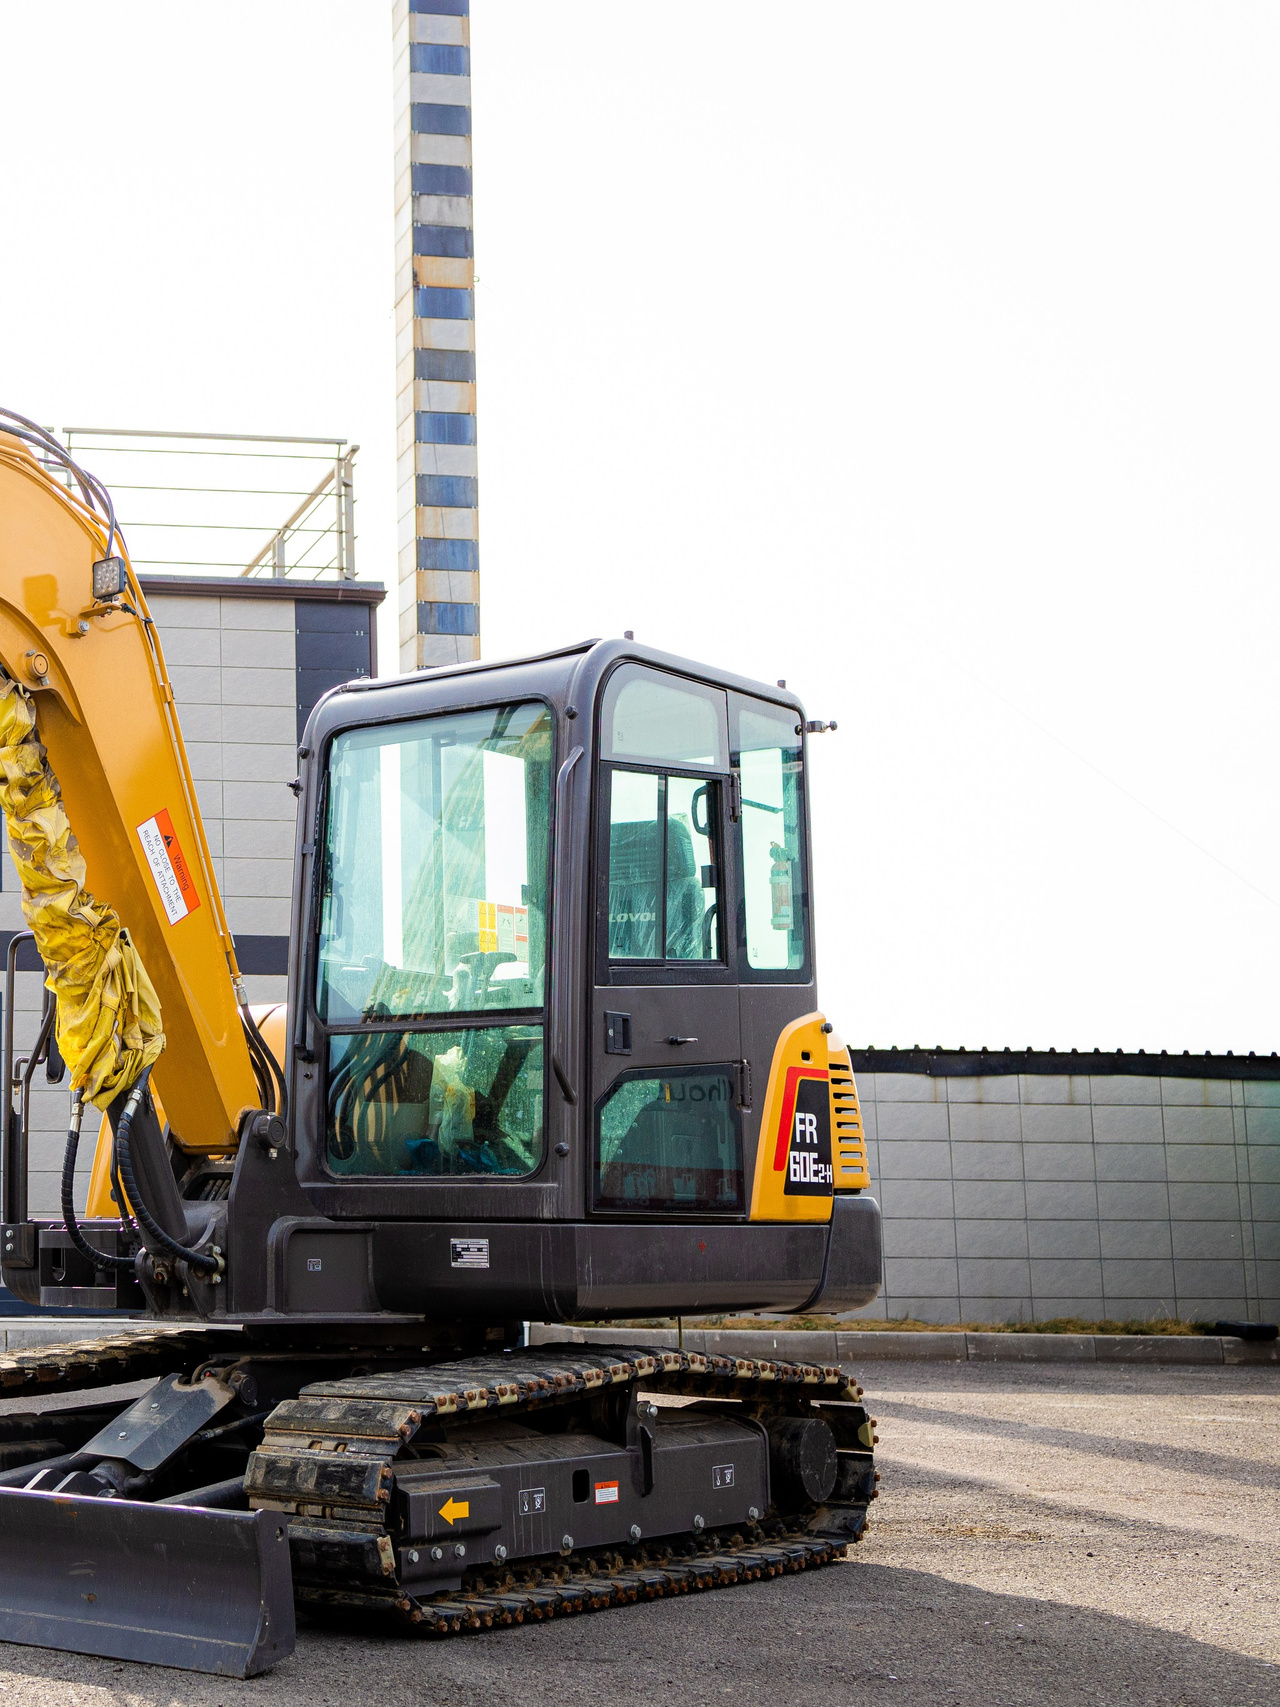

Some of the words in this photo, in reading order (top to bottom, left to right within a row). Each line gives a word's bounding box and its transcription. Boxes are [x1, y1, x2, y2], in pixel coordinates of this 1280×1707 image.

[143, 829, 155, 856] REACH
[152, 857, 161, 868] OF
[157, 870, 178, 916] ATTACHMENT
[153, 834, 161, 846] NO
[158, 848, 171, 873] CLOSE
[168, 874, 175, 886] TO
[173, 887, 182, 903] THE
[173, 854, 190, 891] Warning
[795, 1112, 818, 1144] FR
